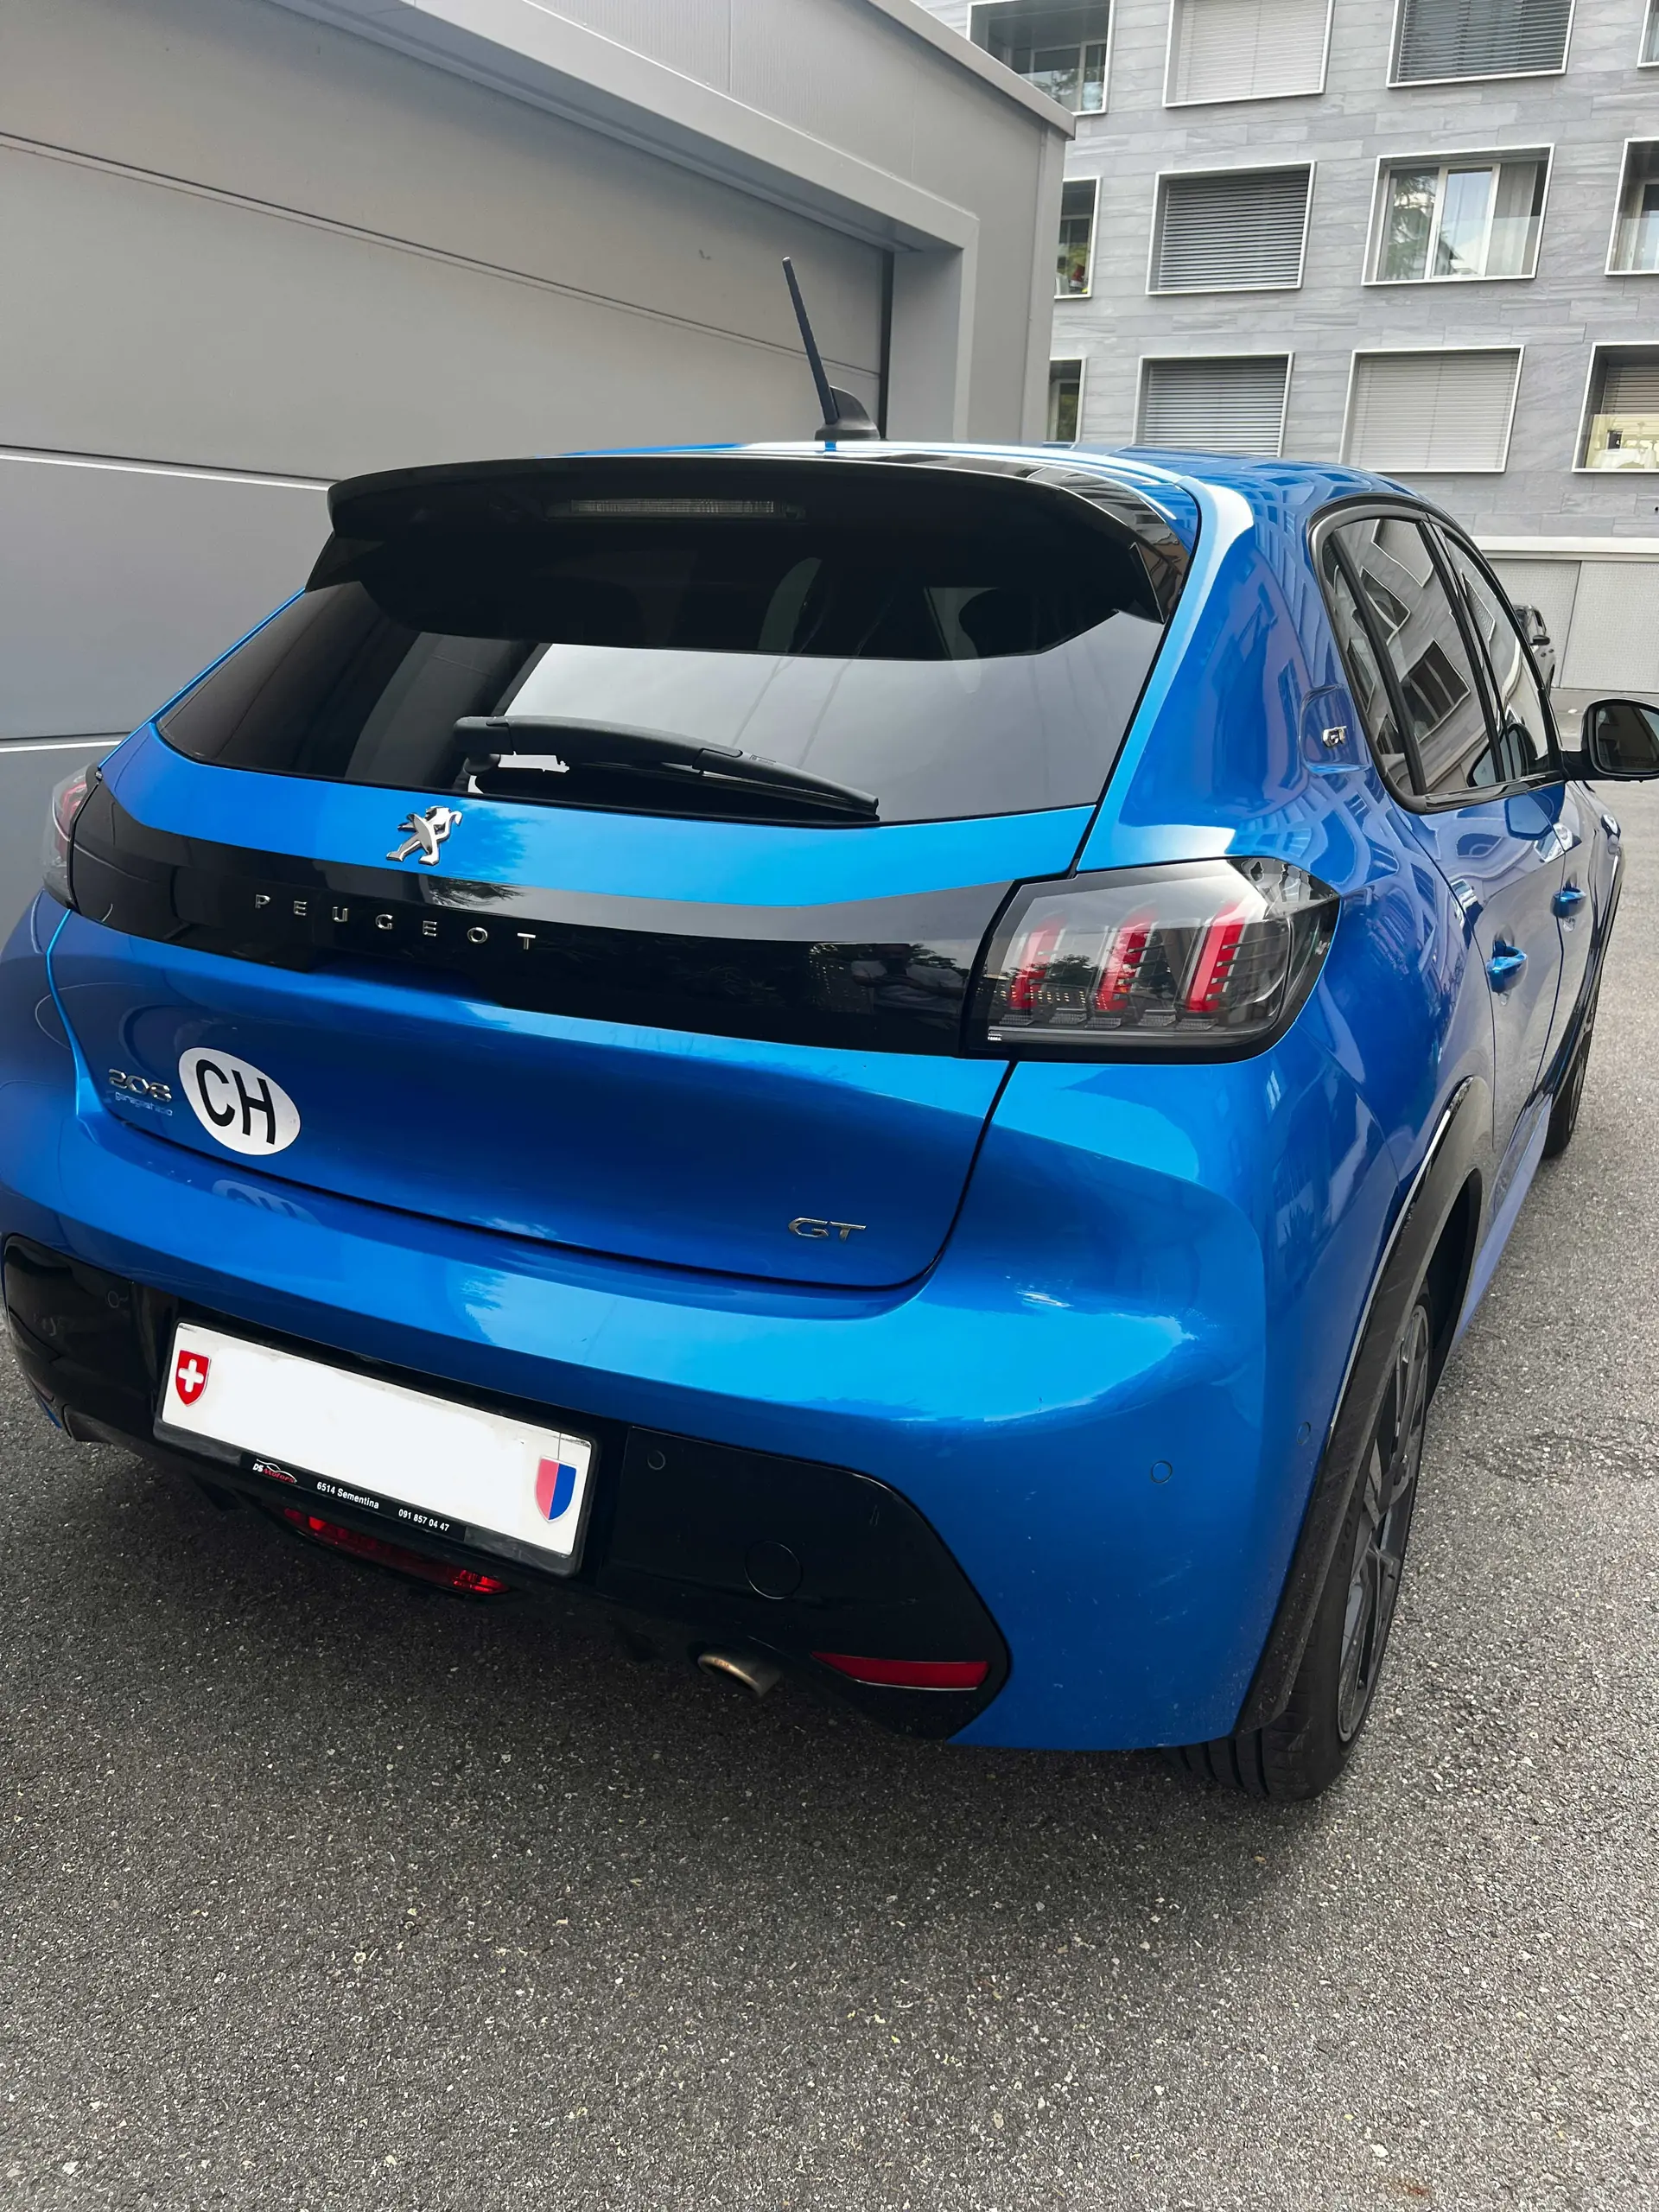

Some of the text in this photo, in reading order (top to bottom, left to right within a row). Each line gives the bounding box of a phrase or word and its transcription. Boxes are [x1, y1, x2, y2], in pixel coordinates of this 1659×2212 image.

[255, 894, 536, 950] PEUGEOT
[109, 1068, 172, 1103] 208
[195, 1058, 276, 1145] CH
[788, 1217, 867, 1242] GT
[252, 1462, 264, 1473] DS
[316, 1481, 450, 1532] 6514 Sementina 091 857 04 47
